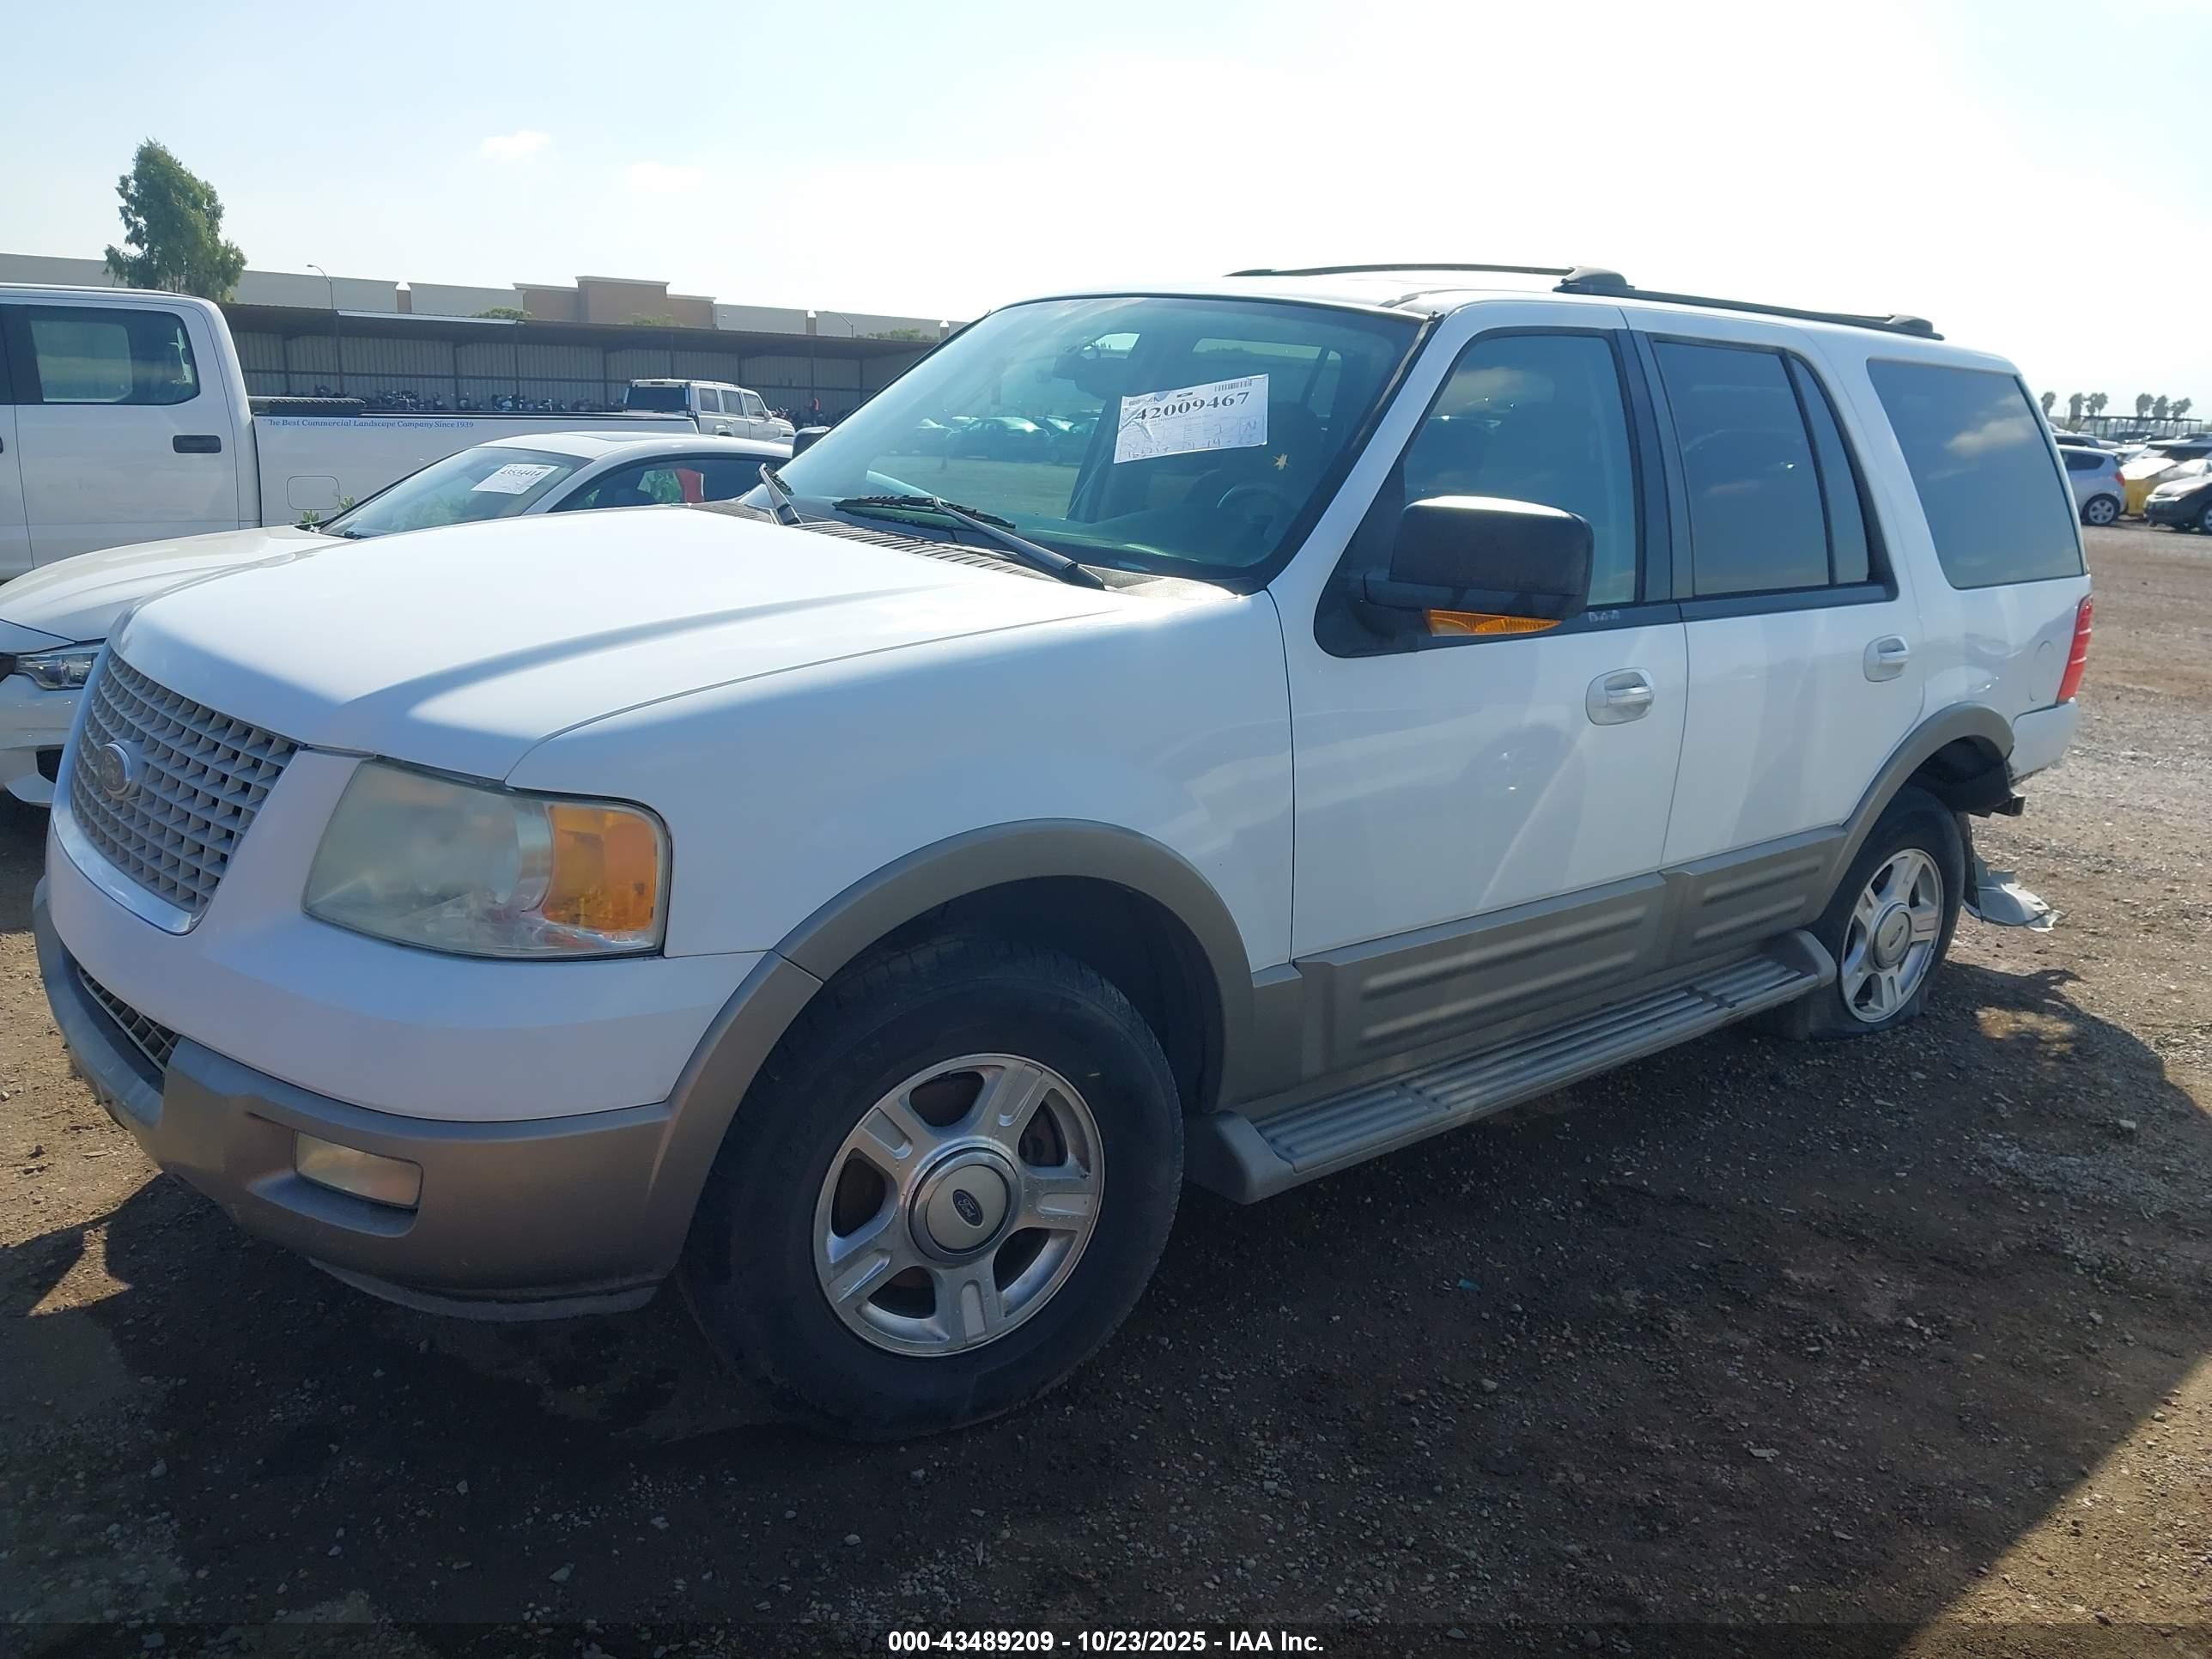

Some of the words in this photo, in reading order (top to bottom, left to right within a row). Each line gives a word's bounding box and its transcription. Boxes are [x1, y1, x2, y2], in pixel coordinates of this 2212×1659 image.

[1134, 392, 1250, 420] 42009467
[282, 419, 301, 428] Best
[302, 419, 351, 428] Commercial
[354, 419, 396, 429] Landscape
[398, 420, 434, 430] Company
